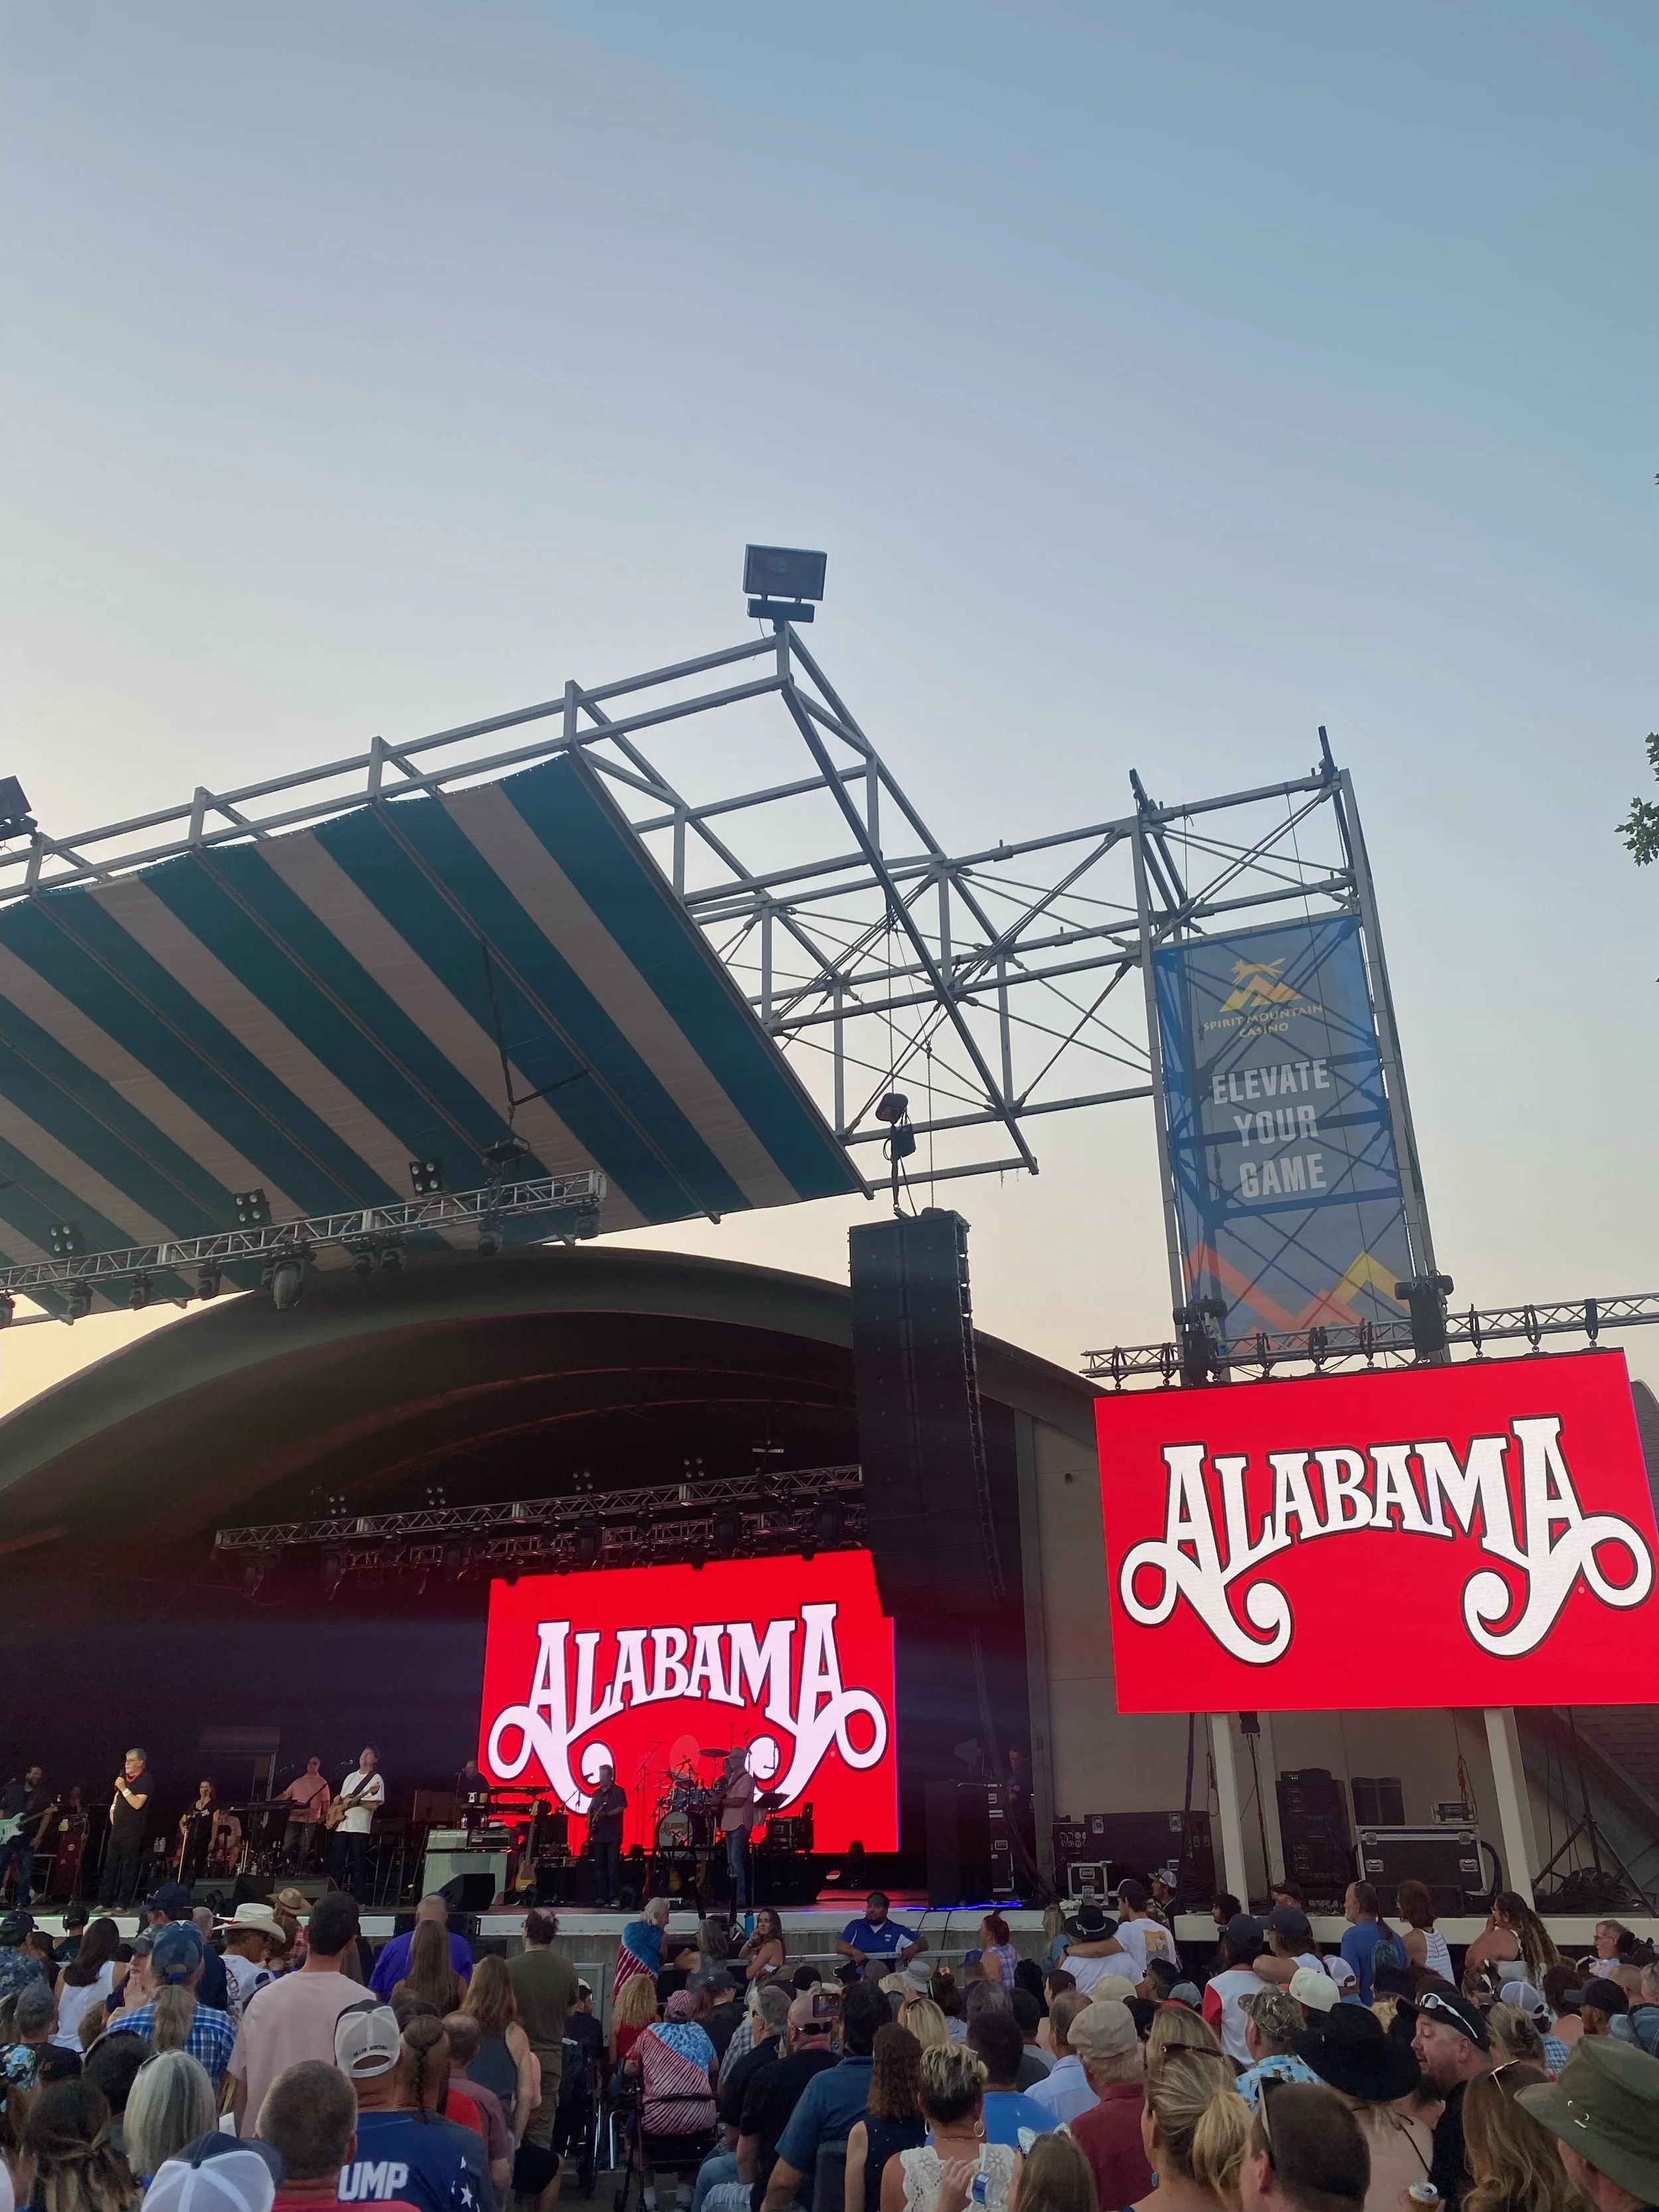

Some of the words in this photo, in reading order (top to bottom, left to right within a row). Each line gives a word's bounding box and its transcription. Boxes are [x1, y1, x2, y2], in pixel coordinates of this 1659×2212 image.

[1203, 1016, 1244, 1031] SPIRIT
[1246, 1003, 1324, 1025] MOUNTAIN
[1239, 1022, 1289, 1038] CASINO
[1212, 1059, 1331, 1105] ELEVATE
[1232, 1104, 1319, 1147] YOUR
[1239, 1153, 1327, 1199] GAME
[1119, 1416, 1654, 1664] ALABAMA
[487, 1603, 887, 1814] ALABAMA
